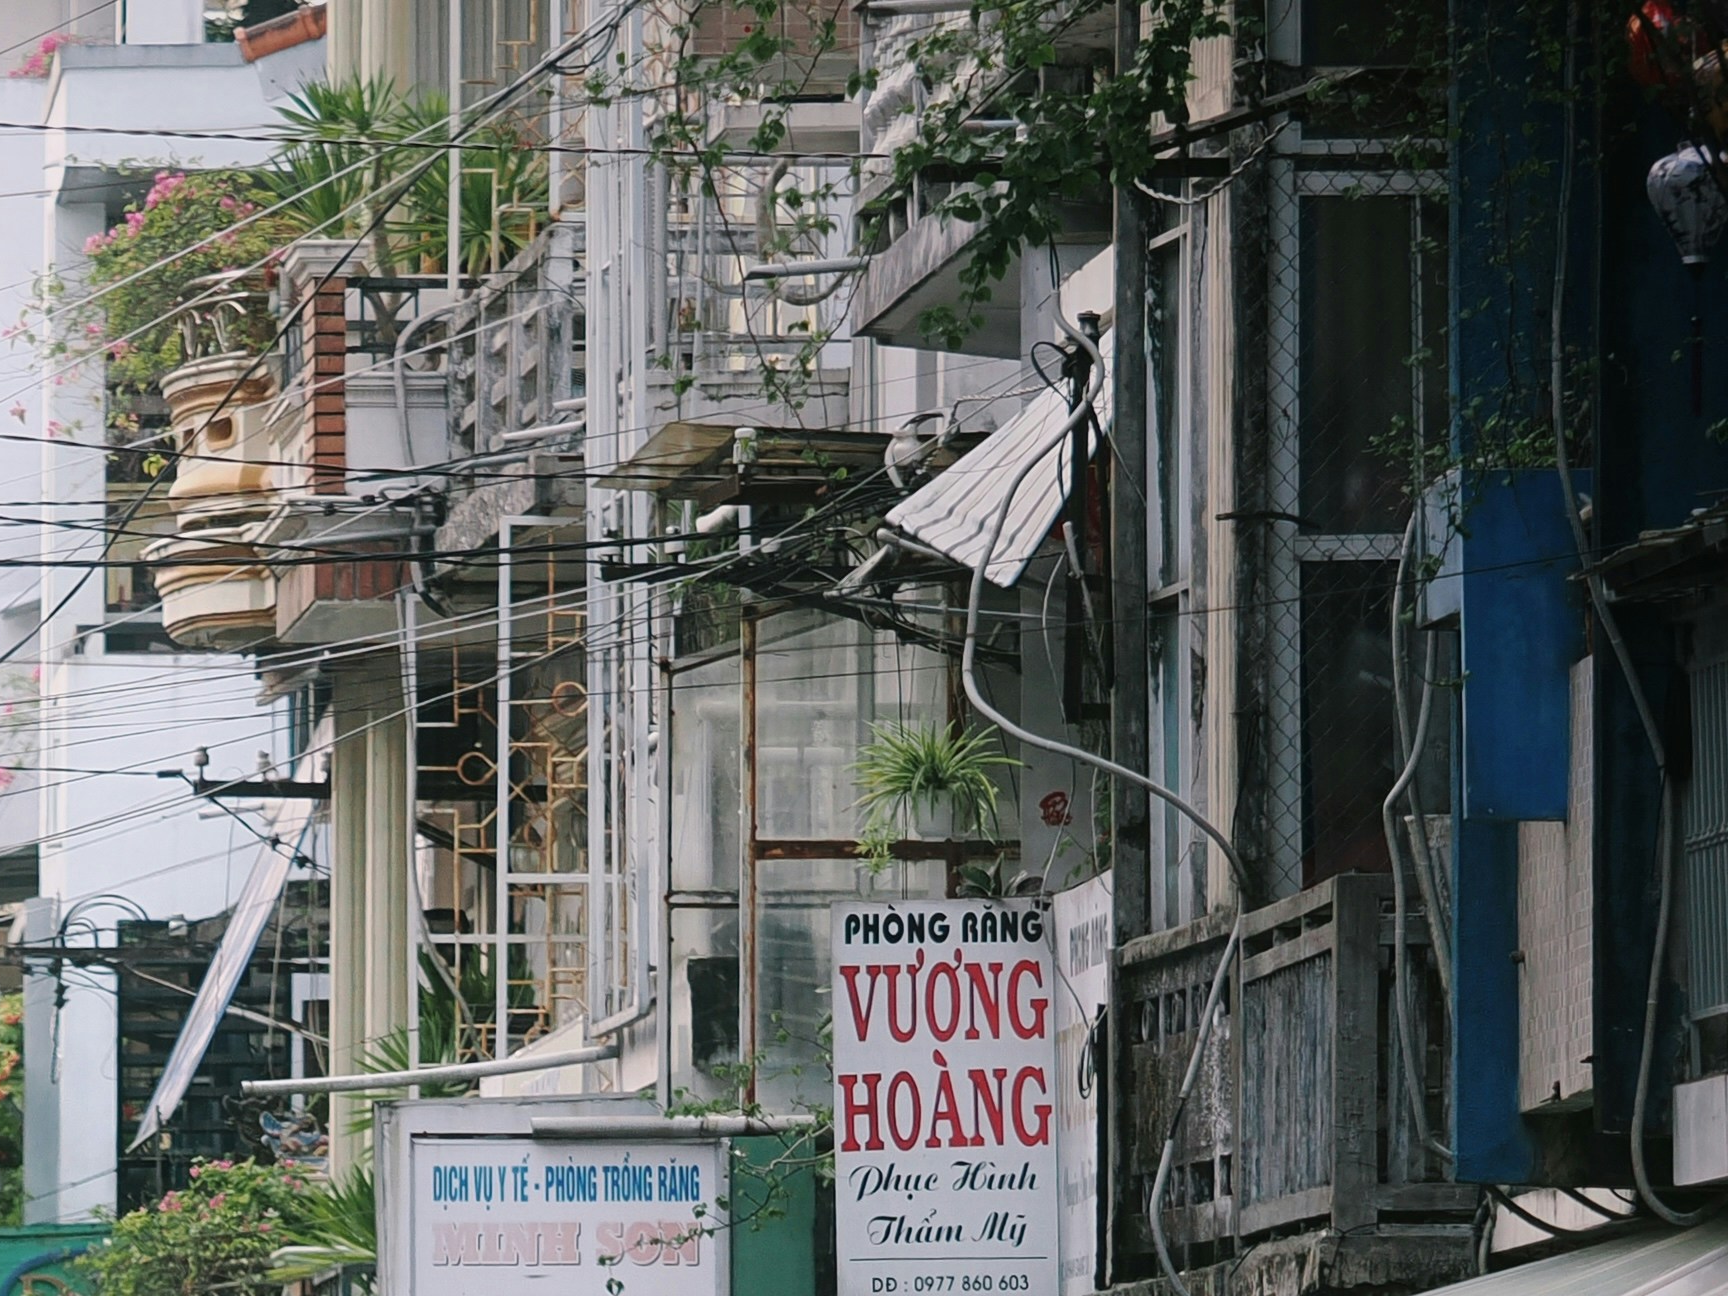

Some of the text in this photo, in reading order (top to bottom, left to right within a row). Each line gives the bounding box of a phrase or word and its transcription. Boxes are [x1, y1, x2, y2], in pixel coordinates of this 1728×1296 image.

[845, 899, 1043, 944] PHÒNG RĂNG
[839, 946, 1049, 1044] VƯƠNG
[838, 1049, 1052, 1152] HOÀNG
[433, 1152, 700, 1211] DỊCH VỤ Y TẾ PHÒNG TRỒNG RĂNG
[848, 1160, 1041, 1202] Phục Hình
[432, 1220, 583, 1268] MINH
[866, 1208, 1028, 1249] Thẩm Mỹ
[914, 1276, 957, 1293] 0977
[962, 1275, 993, 1292] 860
[998, 1275, 1030, 1291] 603
